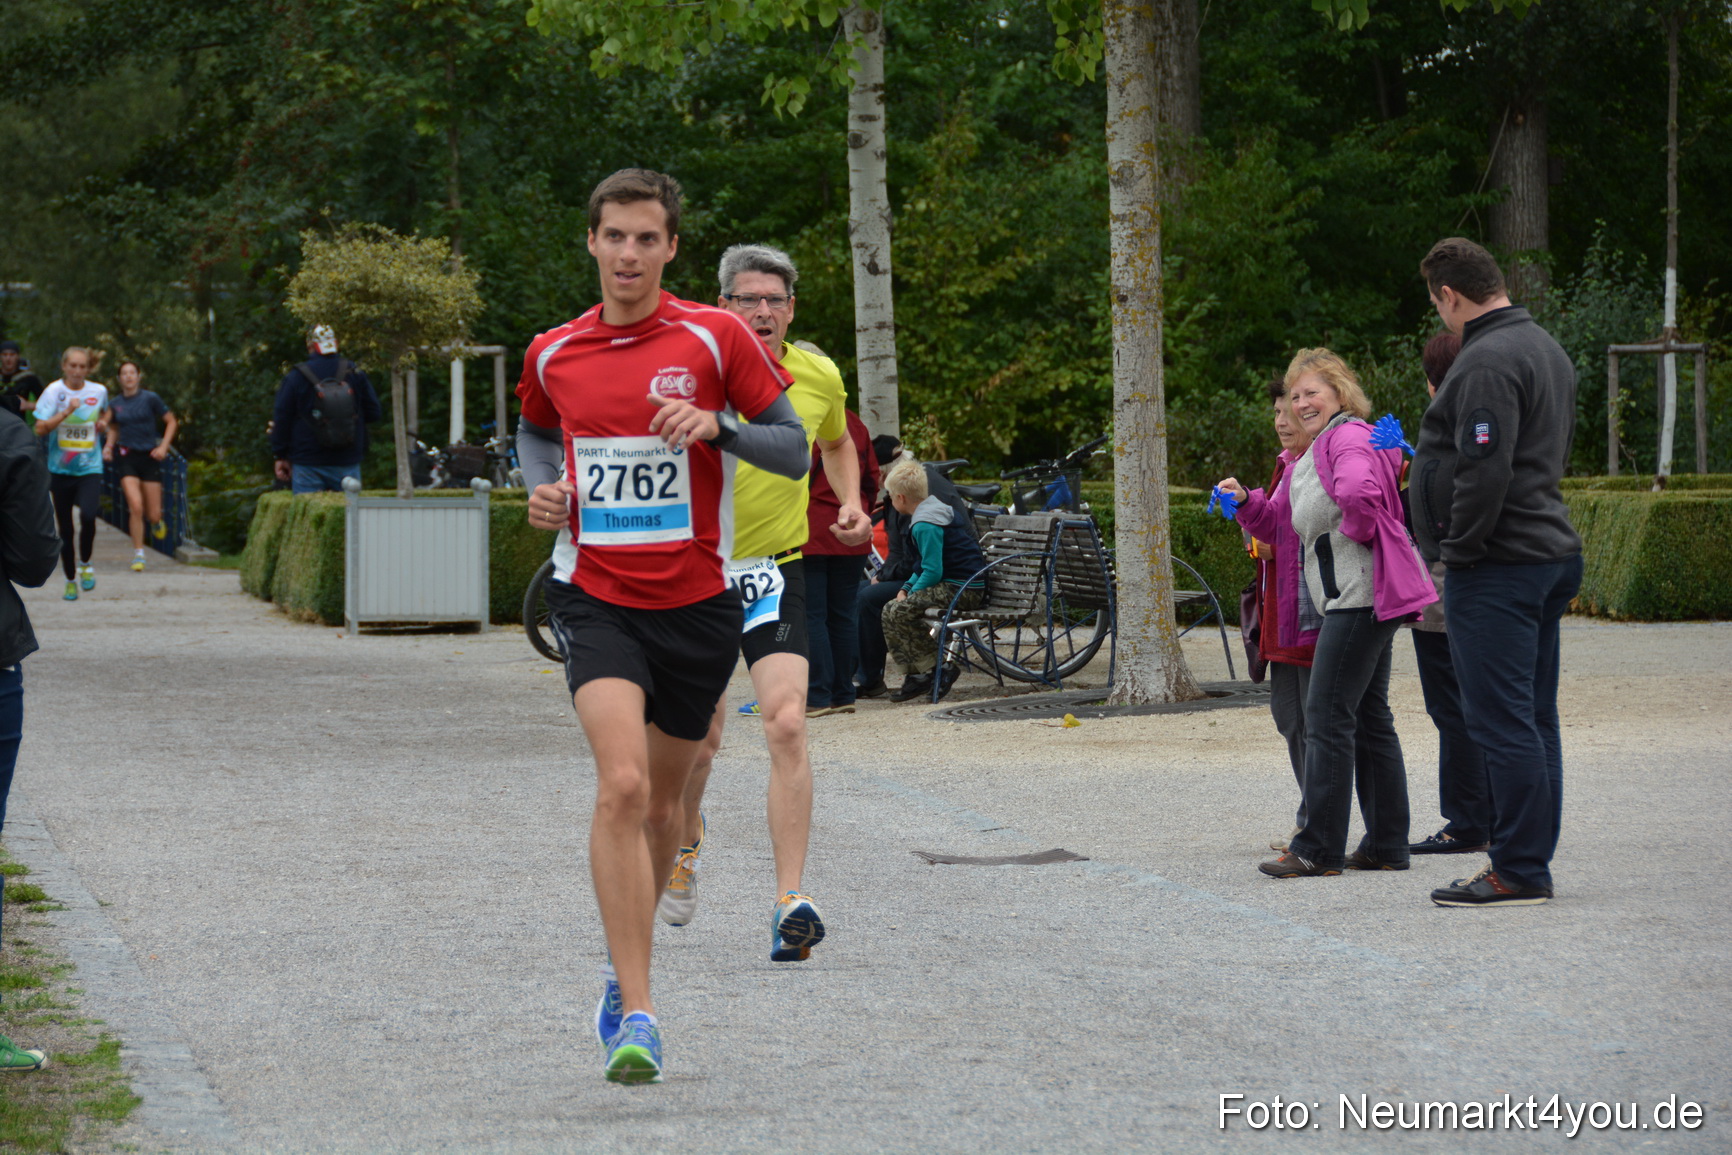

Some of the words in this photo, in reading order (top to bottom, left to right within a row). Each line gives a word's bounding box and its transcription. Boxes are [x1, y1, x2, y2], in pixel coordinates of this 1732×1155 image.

[66, 428, 88, 440] 269
[577, 447, 610, 458] PARTL
[613, 446, 667, 458] Neumarkt
[587, 461, 679, 502] 2762
[602, 512, 662, 529] Thomas
[730, 572, 775, 604] 62
[775, 622, 788, 642] GORE
